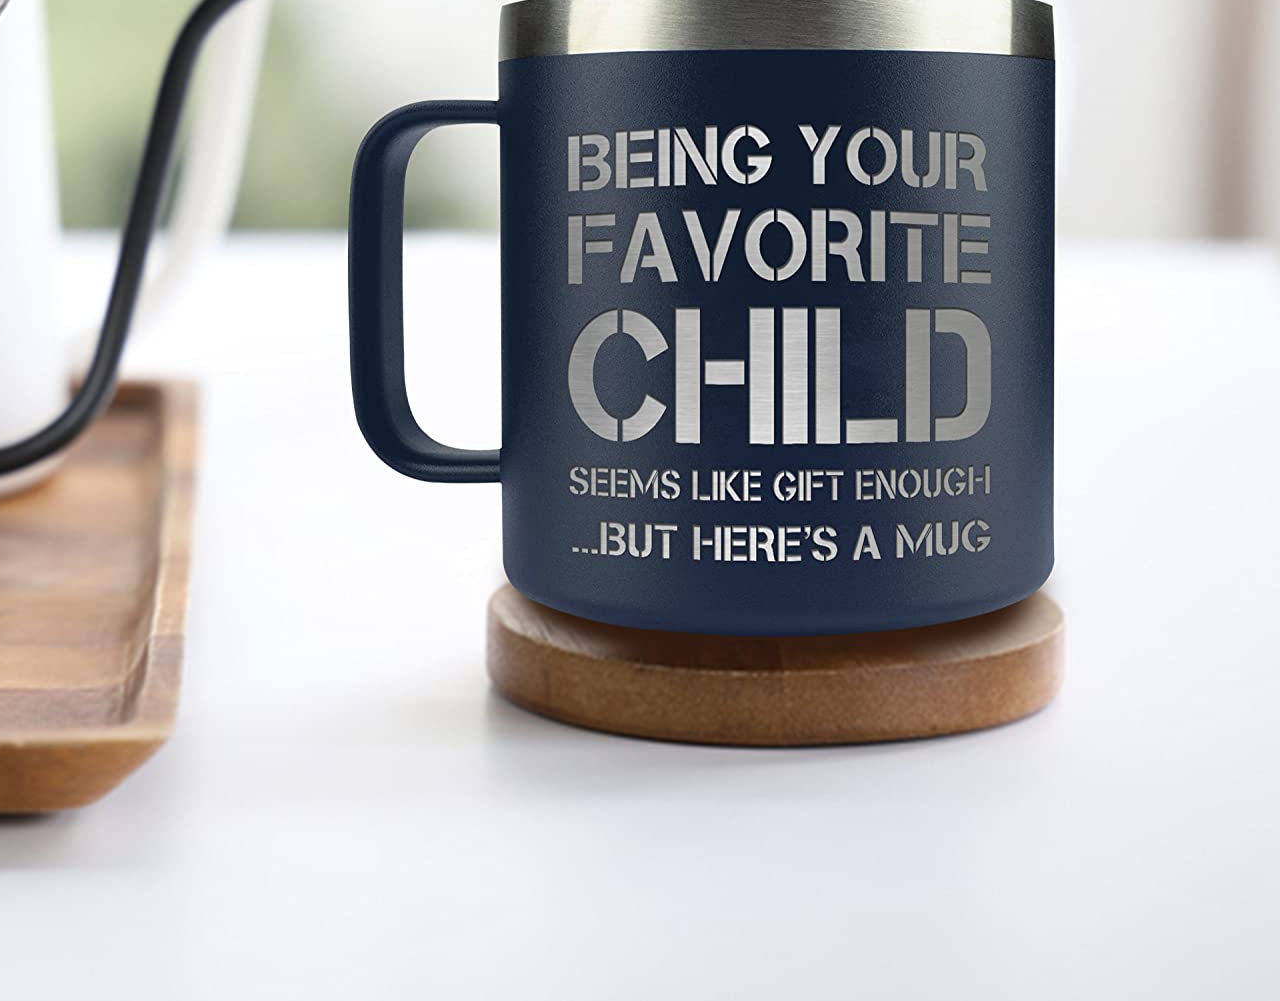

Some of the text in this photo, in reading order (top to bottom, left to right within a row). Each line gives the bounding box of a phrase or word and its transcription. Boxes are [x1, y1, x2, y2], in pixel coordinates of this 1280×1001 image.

[567, 124, 988, 192] BEING YOUR
[567, 208, 992, 285] FAVORITE
[567, 306, 992, 445] CHILD
[569, 465, 992, 502] SEEMS LIKE GIFT ENOUGH
[572, 519, 992, 563] ...BUT HERE'S A MUG
